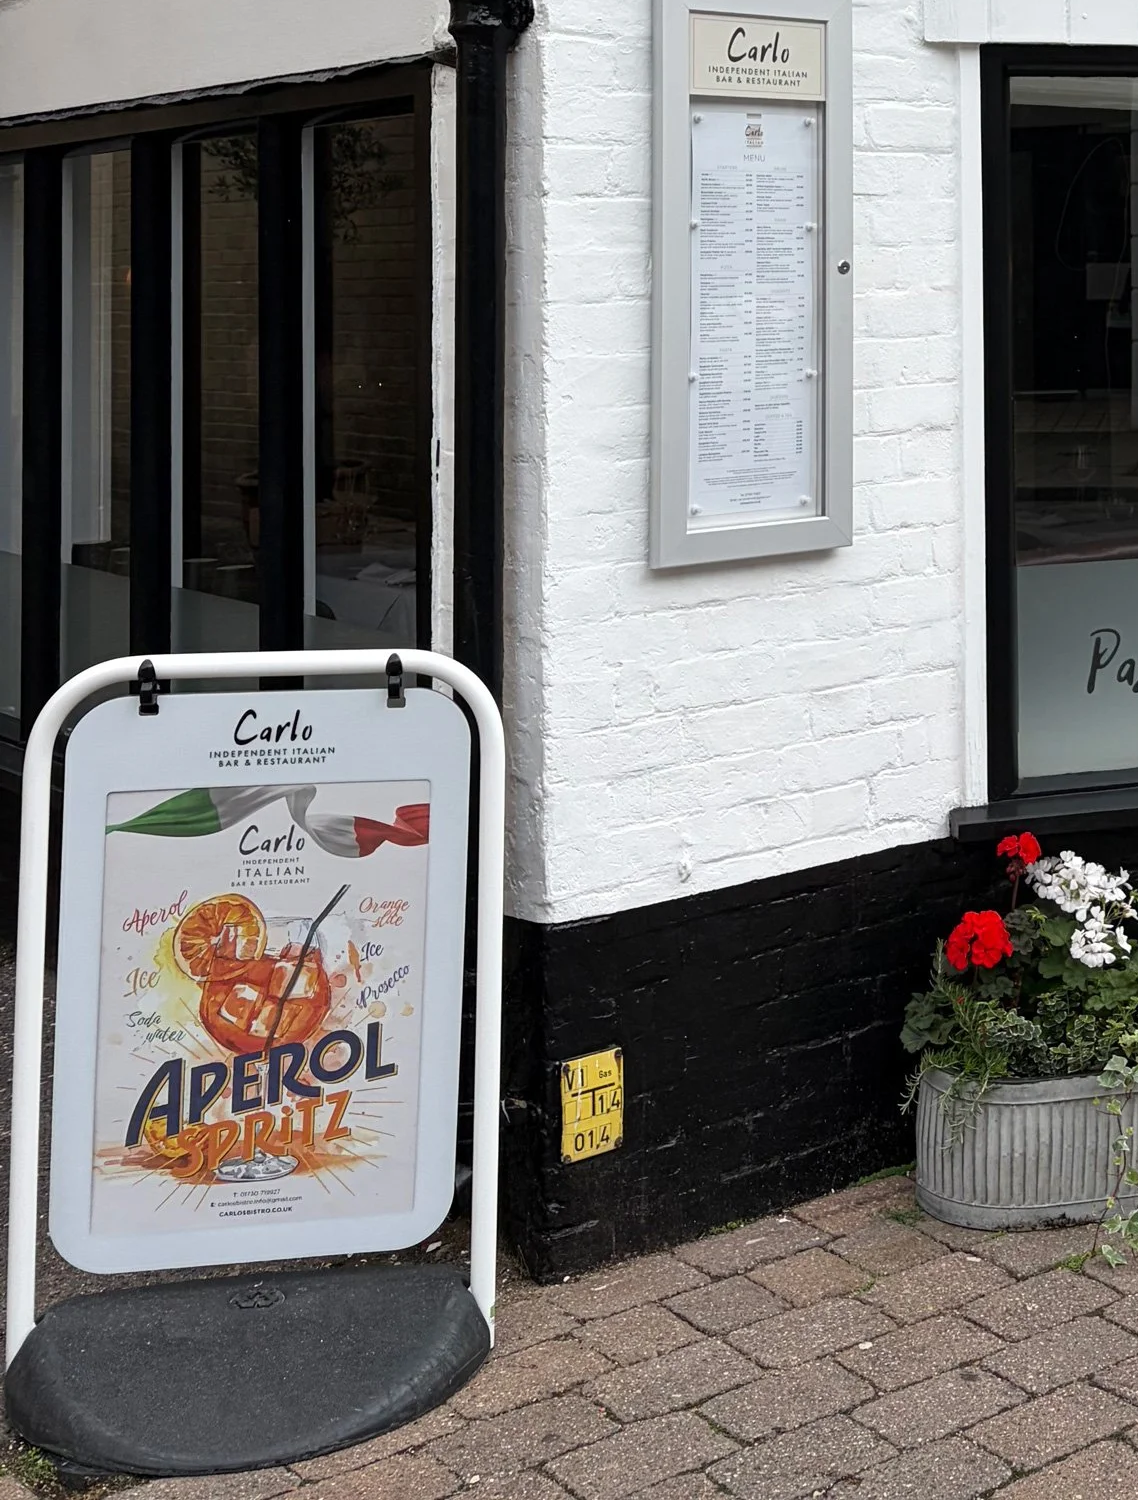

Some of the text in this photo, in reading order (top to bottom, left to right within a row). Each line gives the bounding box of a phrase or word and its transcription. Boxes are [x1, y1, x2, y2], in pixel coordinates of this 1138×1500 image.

[727, 26, 790, 64] Carlo
[708, 66, 808, 78] INDEPENDENT ITALIAN
[746, 77, 800, 87] RESTAURANT
[743, 154, 766, 162] MENU
[234, 709, 313, 746] Carlo
[209, 747, 336, 759] INDEPENDENT ITALIAN
[218, 759, 239, 767] BAR
[257, 756, 326, 766] RESTAURANT
[239, 824, 305, 855] Carlo
[243, 857, 300, 866] INDEPENDENT
[237, 866, 305, 878] ITALIAN
[259, 878, 310, 886] RESTAURANT
[122, 889, 188, 936] Aperol
[359, 896, 410, 914] Orange
[360, 942, 384, 962] Ice
[124, 968, 161, 998] Ice
[356, 965, 410, 1009] Prosecco
[126, 1011, 161, 1028] Soda
[142, 1026, 186, 1045] water
[599, 1070, 612, 1078] Gas
[125, 1022, 398, 1149] APEROL
[219, 1206, 292, 1217] CARLOSBISTRO.CO.UK
